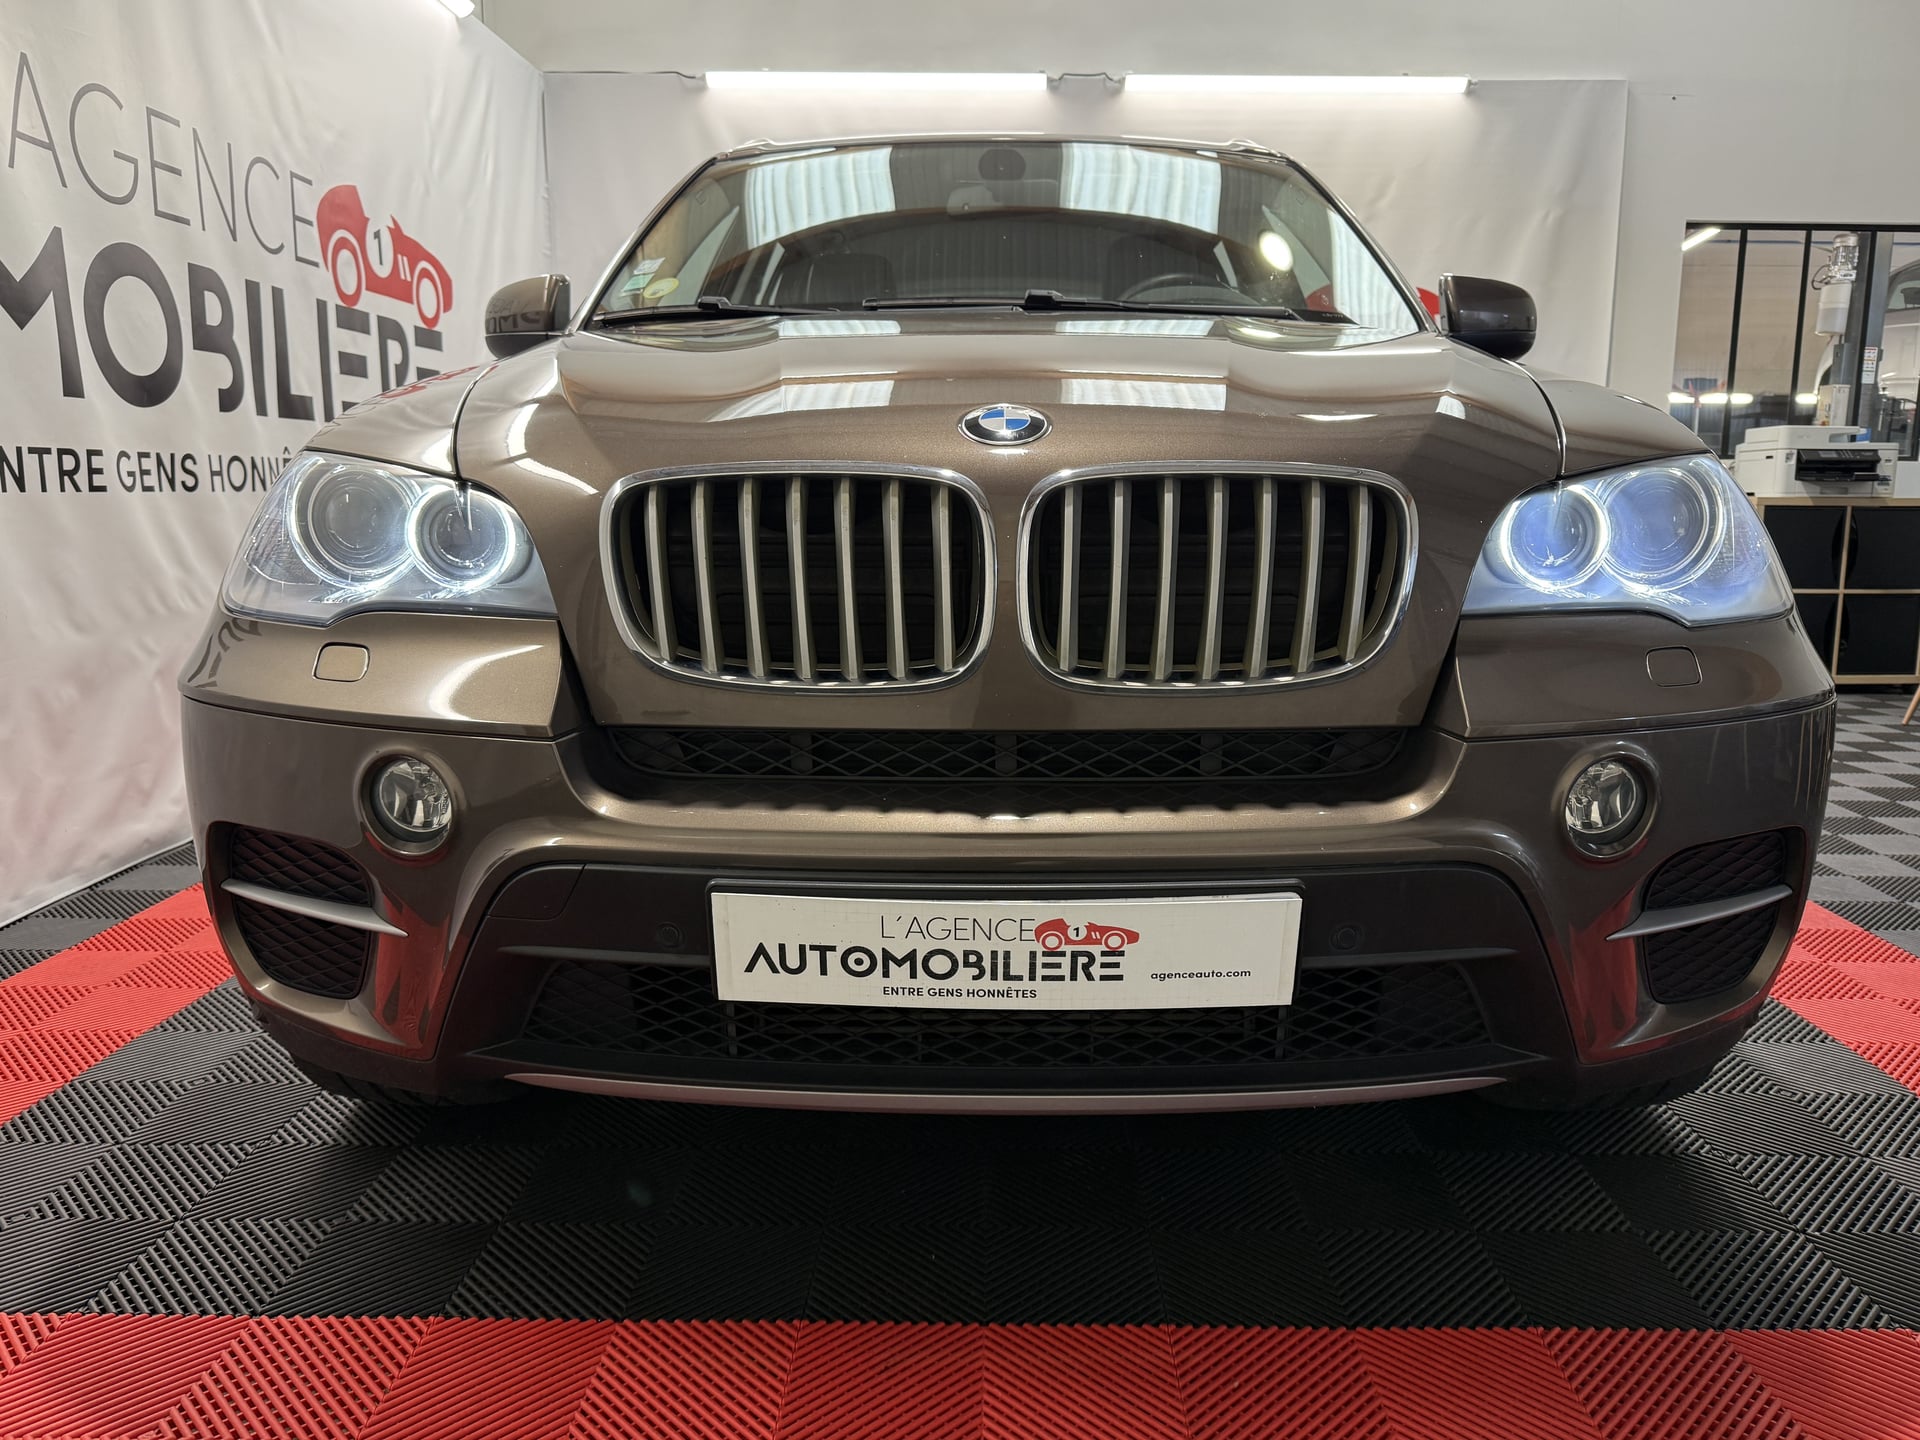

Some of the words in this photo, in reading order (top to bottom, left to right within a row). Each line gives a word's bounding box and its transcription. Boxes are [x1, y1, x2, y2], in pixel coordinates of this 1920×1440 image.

[8, 52, 320, 269] AGENCE
[373, 229, 383, 266] 1
[116, 450, 199, 493] GENS
[880, 915, 1036, 942] L'AGENCE
[1073, 926, 1080, 938] 1
[743, 942, 1125, 981] AUTOMOBILIERE
[1150, 969, 1251, 982] agenceauto.com
[882, 986, 924, 997] ENTRE
[927, 987, 963, 998] GENS
[966, 986, 1037, 999] HONNÊTES
